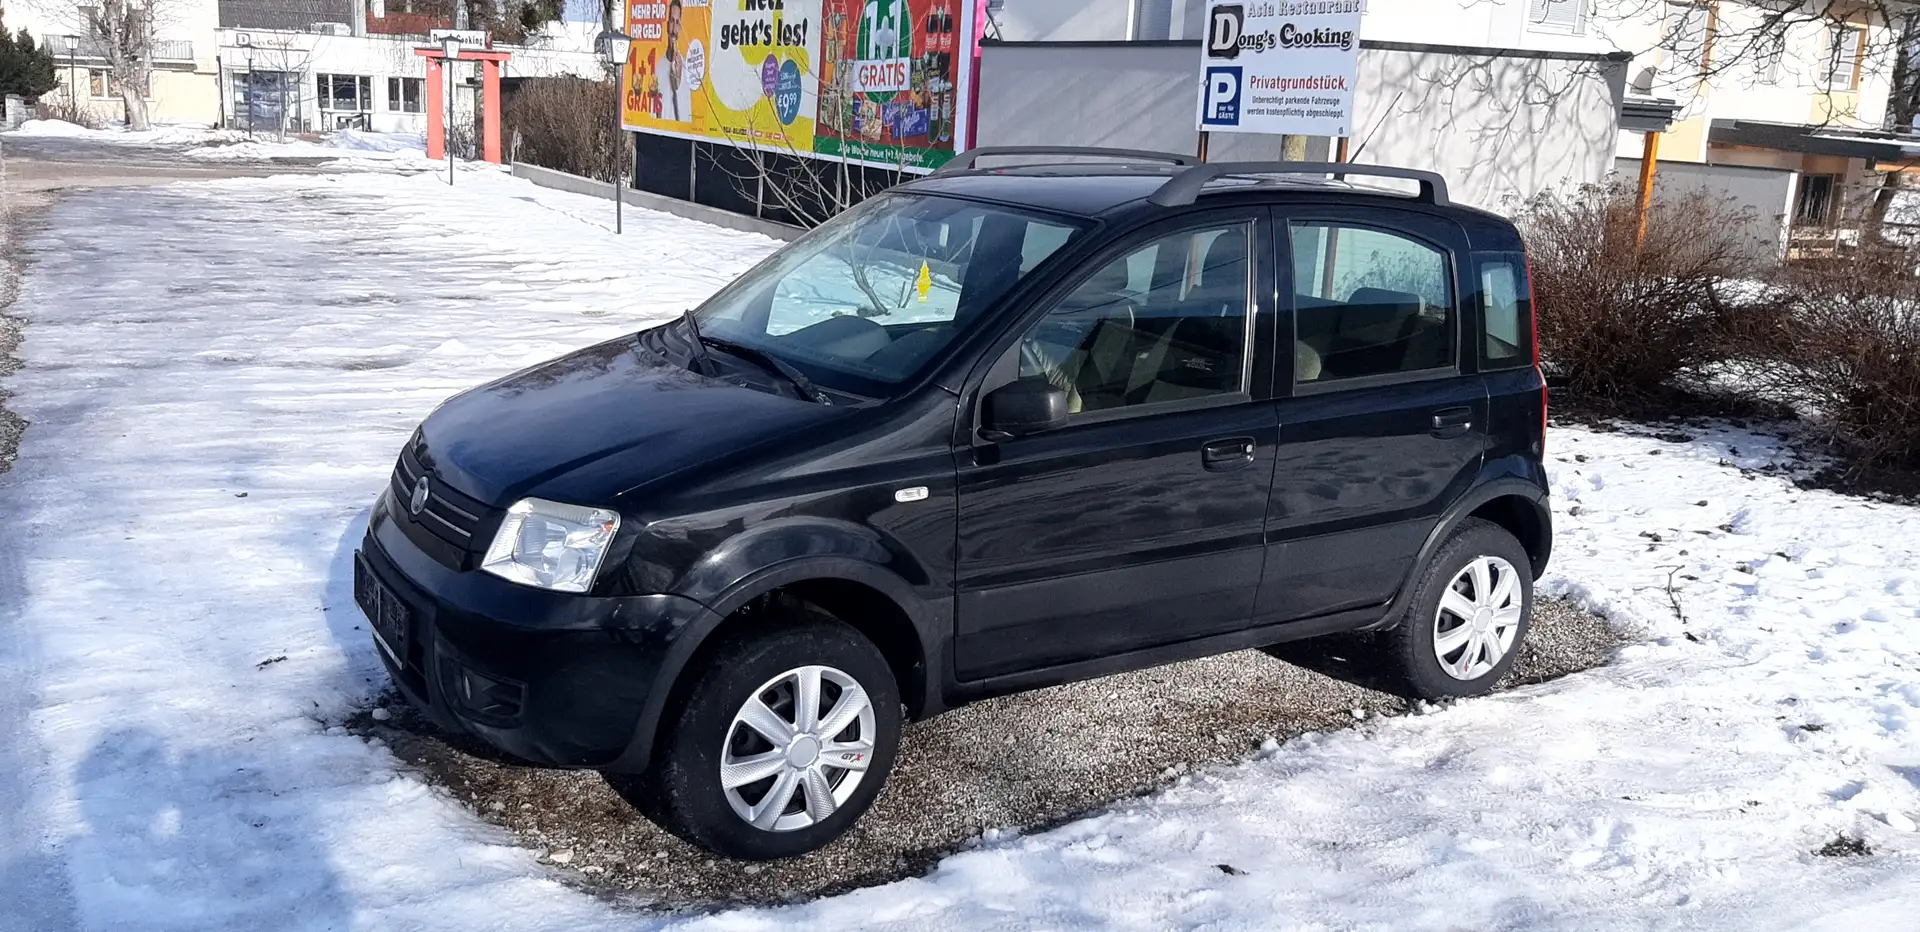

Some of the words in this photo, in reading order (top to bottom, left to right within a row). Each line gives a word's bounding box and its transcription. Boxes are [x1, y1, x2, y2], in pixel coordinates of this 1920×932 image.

[631, 4, 652, 19] MEHR
[652, 0, 666, 19] FÜR
[1247, 2, 1275, 18] Asia
[1279, 0, 1360, 17] Restaurant
[630, 24, 642, 39] IHR
[643, 23, 662, 39] GELD
[720, 19, 772, 50] geht's
[777, 18, 808, 46] los!
[1211, 12, 1275, 52] Dong's
[1280, 23, 1354, 50] Cooking
[858, 62, 906, 88] GRATIS
[1250, 75, 1345, 92] Privatgrundstück
[626, 90, 663, 114] GRATIS
[1207, 72, 1237, 119] P
[1252, 96, 1284, 105] Unberechtigt
[1285, 96, 1310, 105] parkende
[1311, 96, 1340, 106] Fahrzeuge
[1247, 108, 1266, 116] werden
[1266, 107, 1305, 118] kostenpflichtig
[837, 142, 851, 154] Jde
[869, 149, 884, 158] neue
[894, 150, 924, 163] Agebote.
